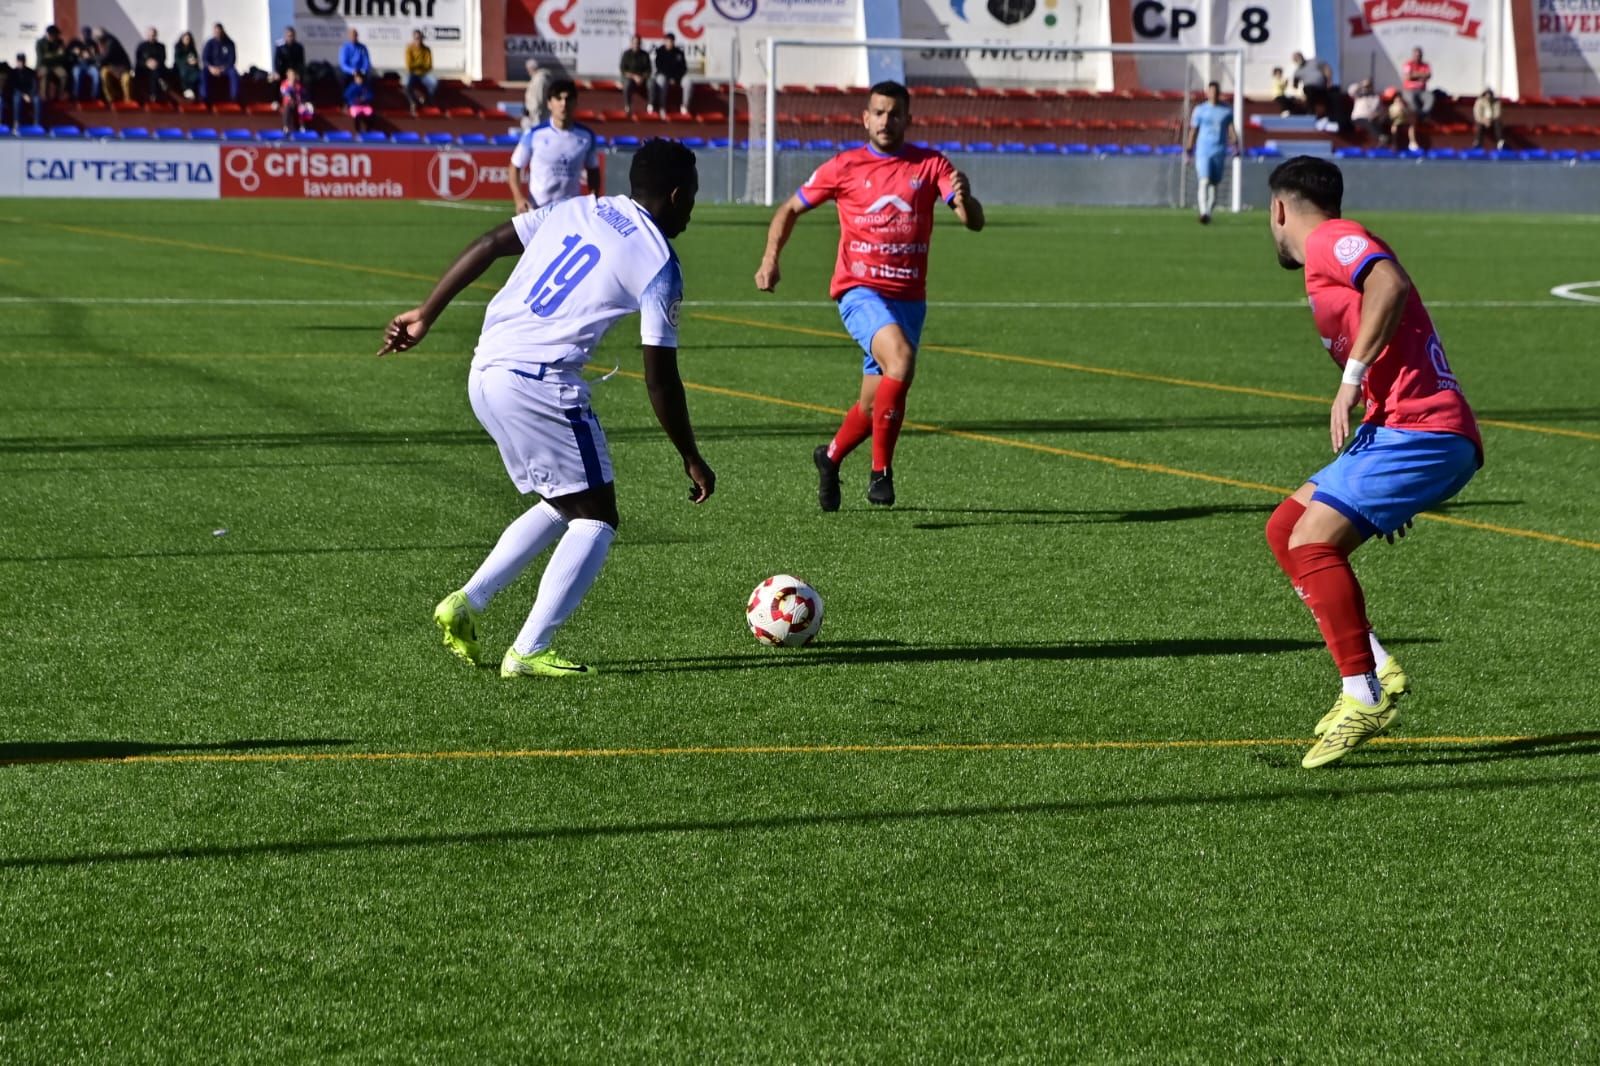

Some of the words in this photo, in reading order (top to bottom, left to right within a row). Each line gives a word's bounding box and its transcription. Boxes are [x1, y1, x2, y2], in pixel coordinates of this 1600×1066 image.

[1241, 7, 1269, 43] 8
[264, 148, 372, 177] crisan
[303, 179, 403, 197] lavanderia
[524, 233, 601, 318] 19
